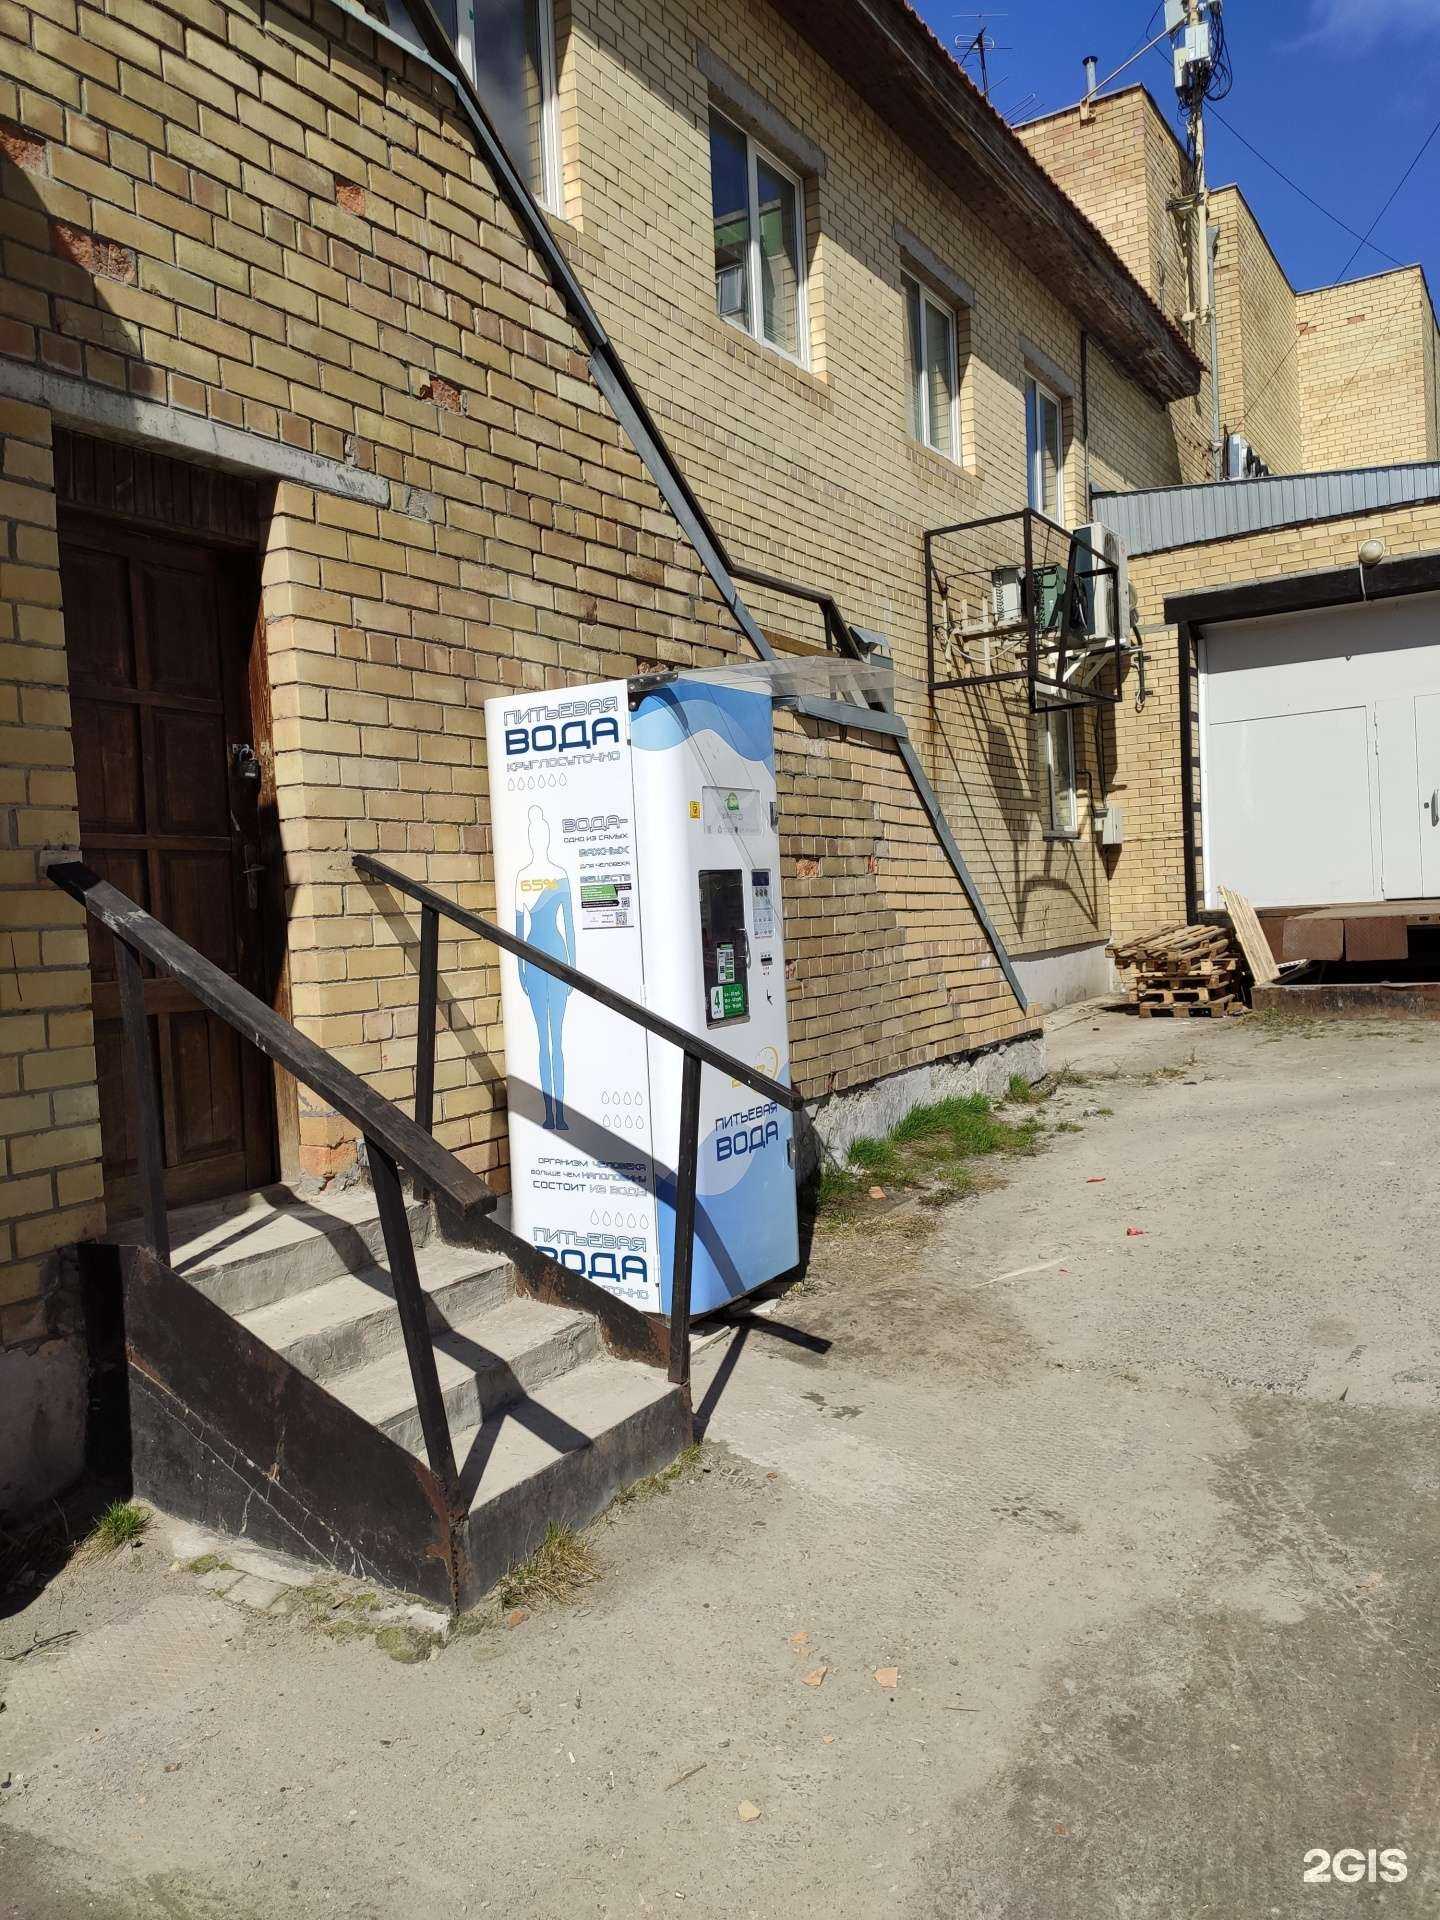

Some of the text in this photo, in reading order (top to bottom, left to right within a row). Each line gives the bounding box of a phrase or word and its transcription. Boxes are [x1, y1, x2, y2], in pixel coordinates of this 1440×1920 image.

[504, 696, 618, 726] ПИТЬЕВАЯ
[505, 717, 619, 755] ВОДА
[507, 751, 620, 772] КРУГЛОСУТОЧНО
[599, 833, 628, 841] САМЫХ
[715, 1101, 778, 1131] ПИТЬЕВАЯ
[716, 1121, 779, 1161] ВОДА
[530, 1169, 561, 1177] БОЛЬШЕ
[538, 1157, 588, 1167] ОРГАНИЗМ
[533, 1180, 586, 1192] СОСТОИТ
[590, 1184, 606, 1193] ИЗ
[533, 1227, 647, 1253] ПИТЬЕВАЯ
